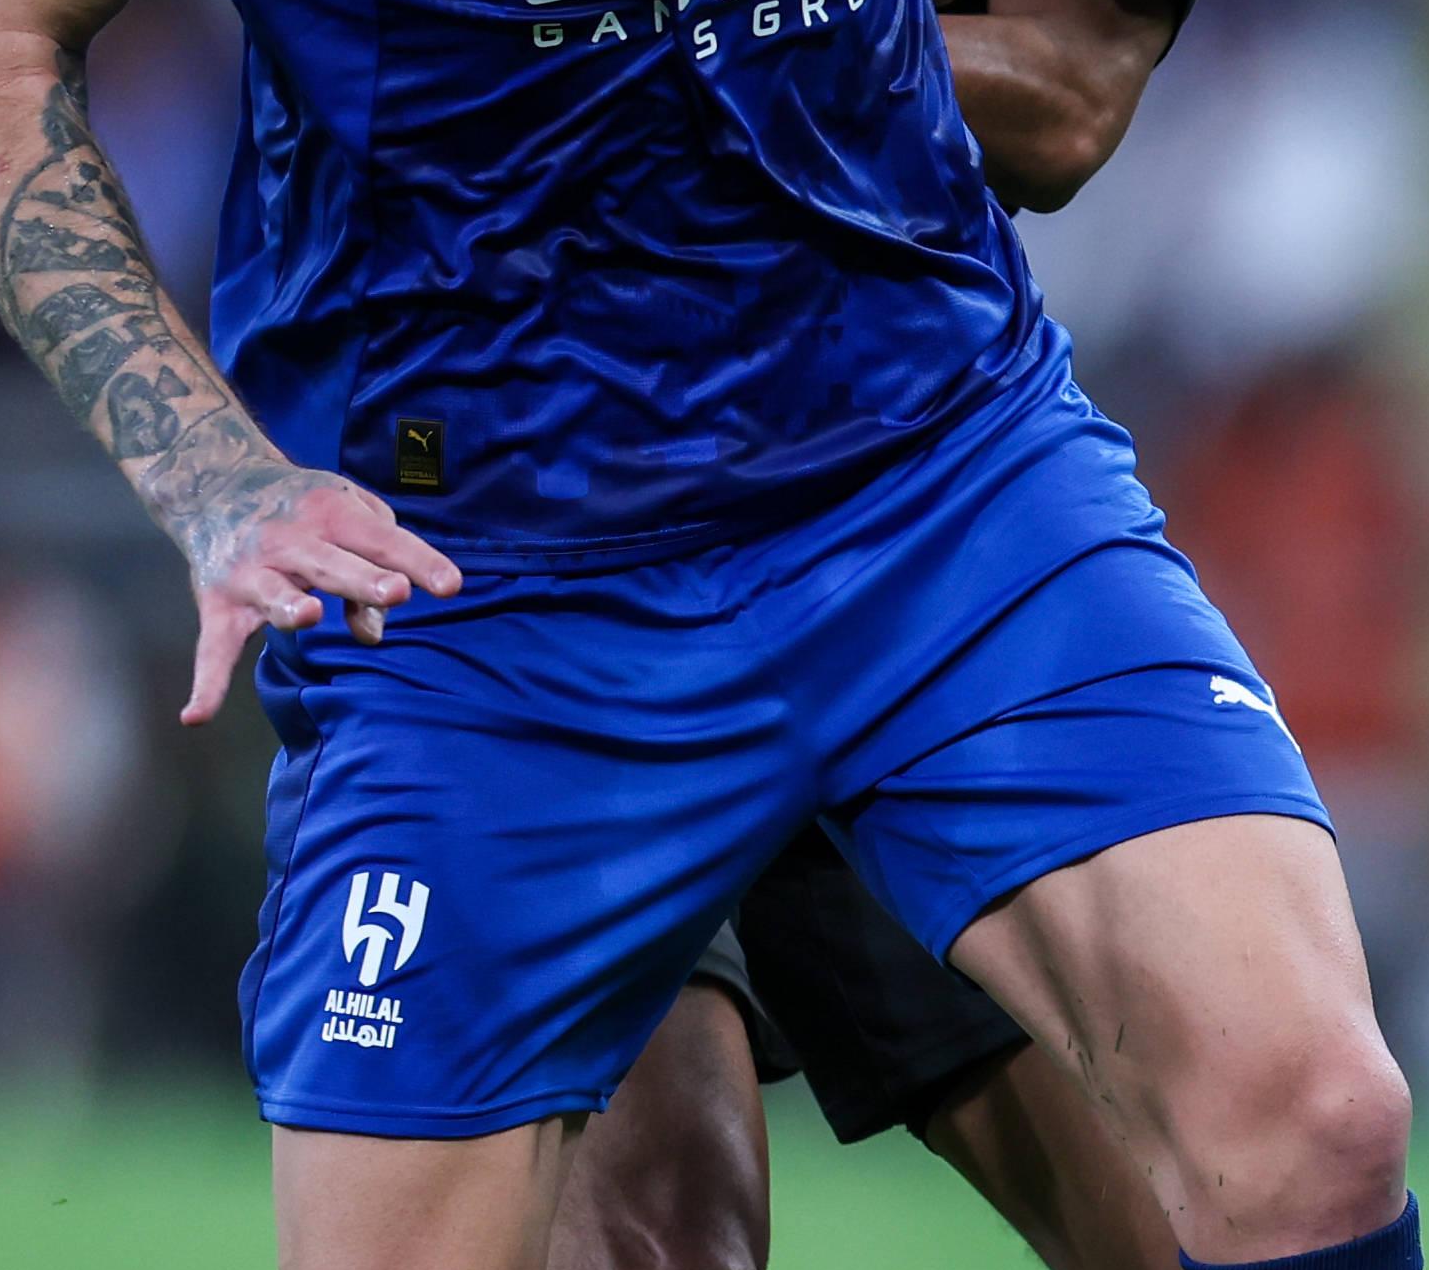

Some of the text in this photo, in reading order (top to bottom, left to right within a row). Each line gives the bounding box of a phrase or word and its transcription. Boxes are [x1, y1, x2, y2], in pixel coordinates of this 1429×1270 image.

[533, 0, 718, 60] GAS
[324, 989, 403, 1023] ALHILAL
[321, 1016, 396, 1048] الهلال
